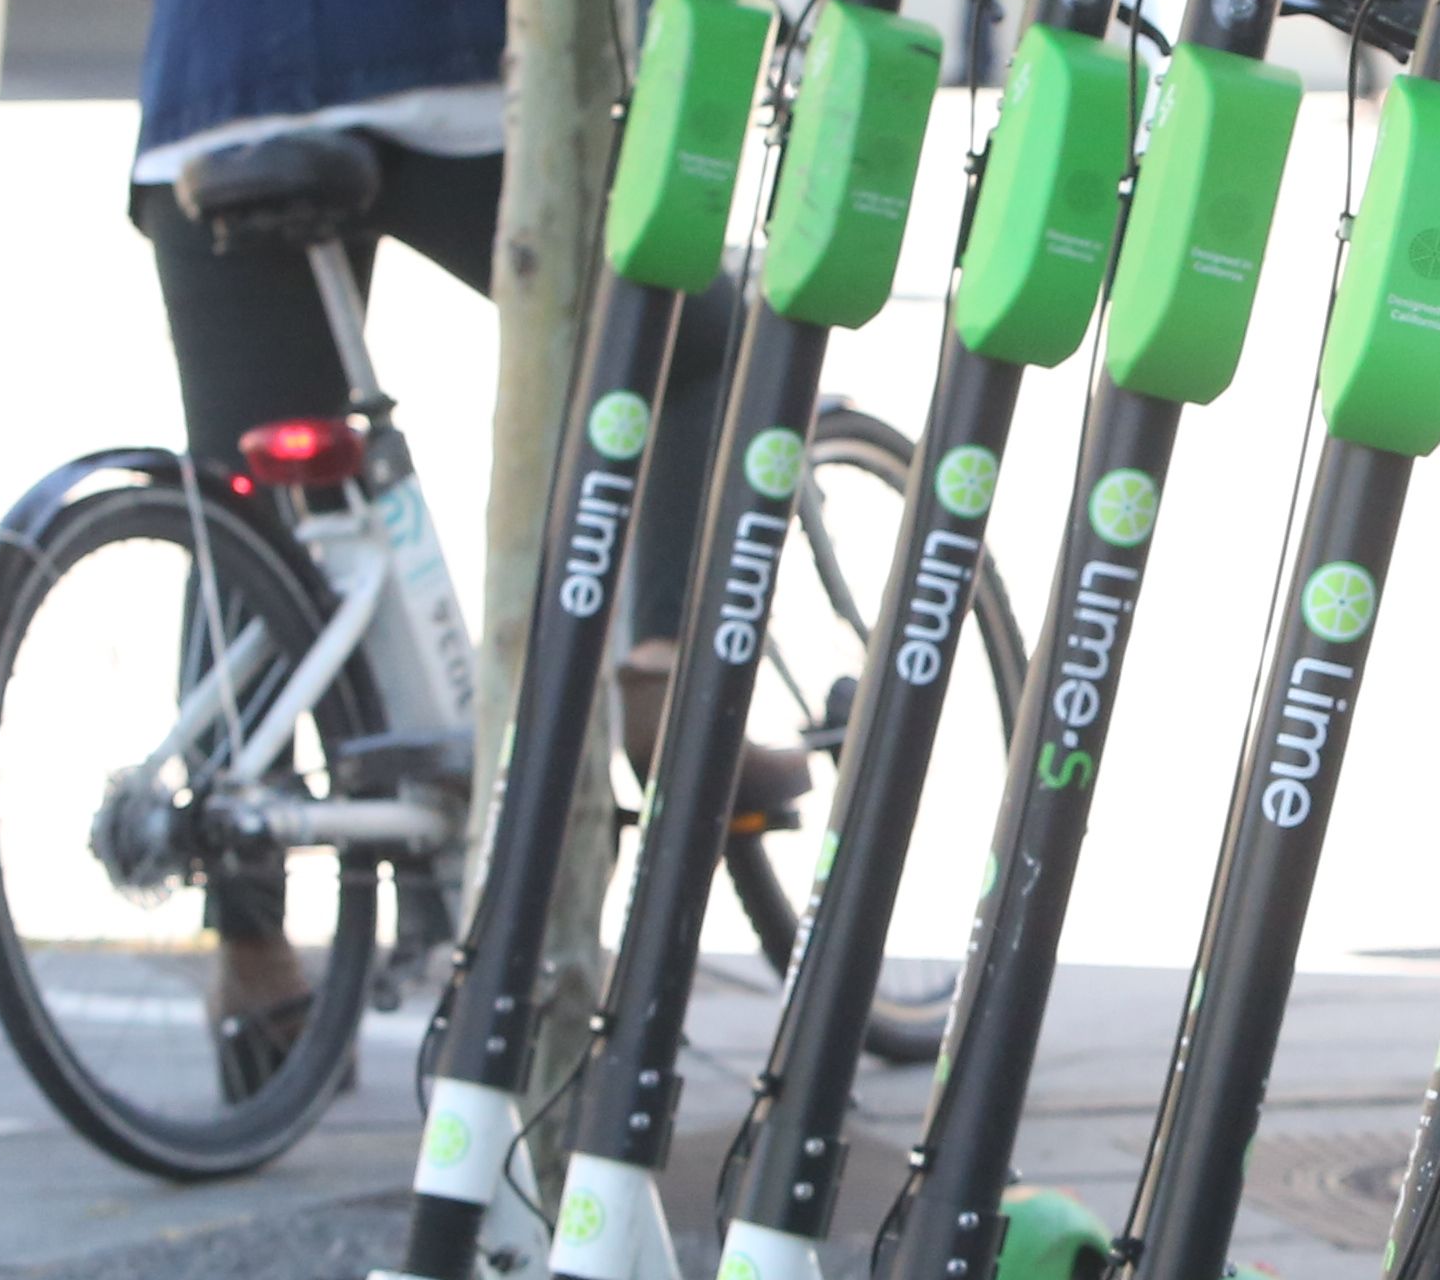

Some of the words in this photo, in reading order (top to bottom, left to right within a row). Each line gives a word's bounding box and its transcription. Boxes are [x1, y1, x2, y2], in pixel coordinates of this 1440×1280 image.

[560, 469, 633, 618] Lime
[713, 511, 788, 665] Lime
[896, 527, 980, 687] Lime
[1261, 656, 1354, 828] Lime
